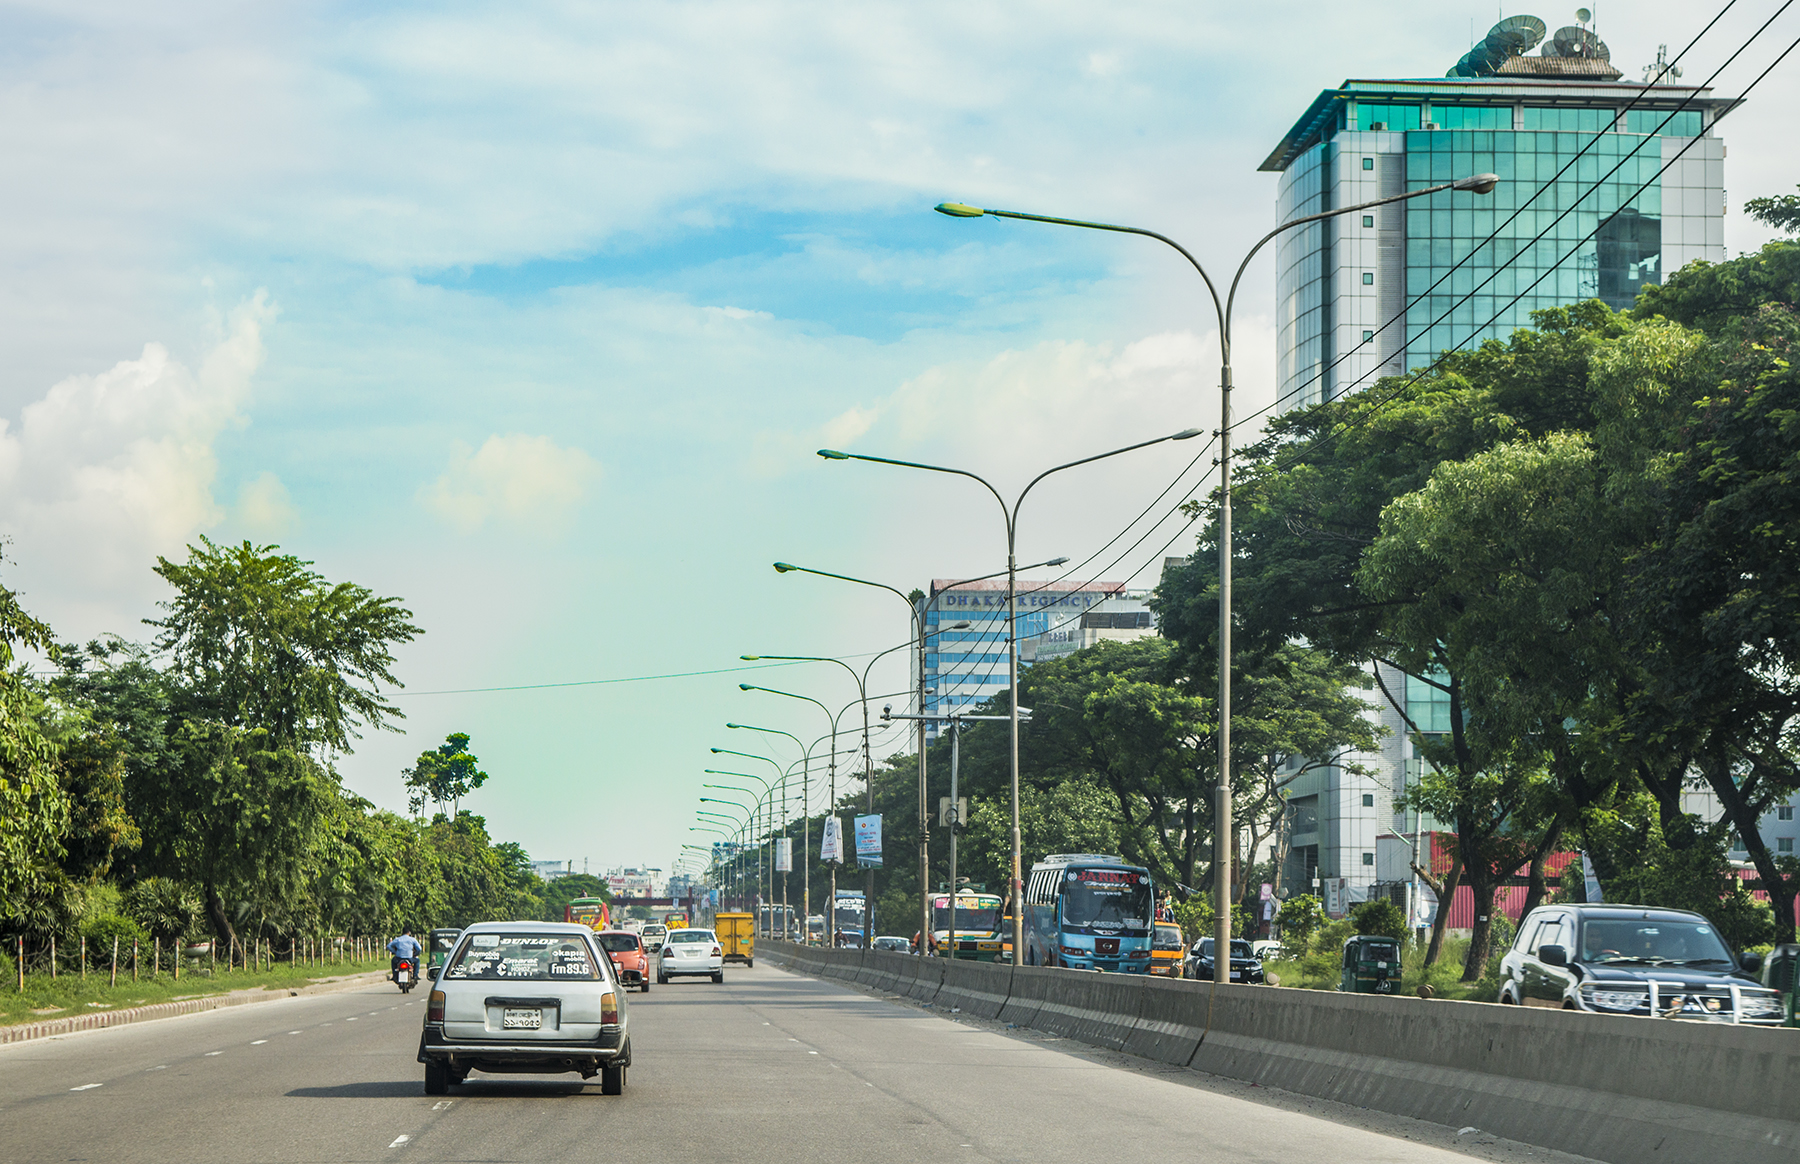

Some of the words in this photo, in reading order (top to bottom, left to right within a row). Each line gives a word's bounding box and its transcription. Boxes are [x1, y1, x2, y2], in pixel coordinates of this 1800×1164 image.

[947, 595, 1007, 606] DHAKA
[1020, 596, 1092, 606] REGENCY
[1077, 871, 1140, 884] JANNAT
